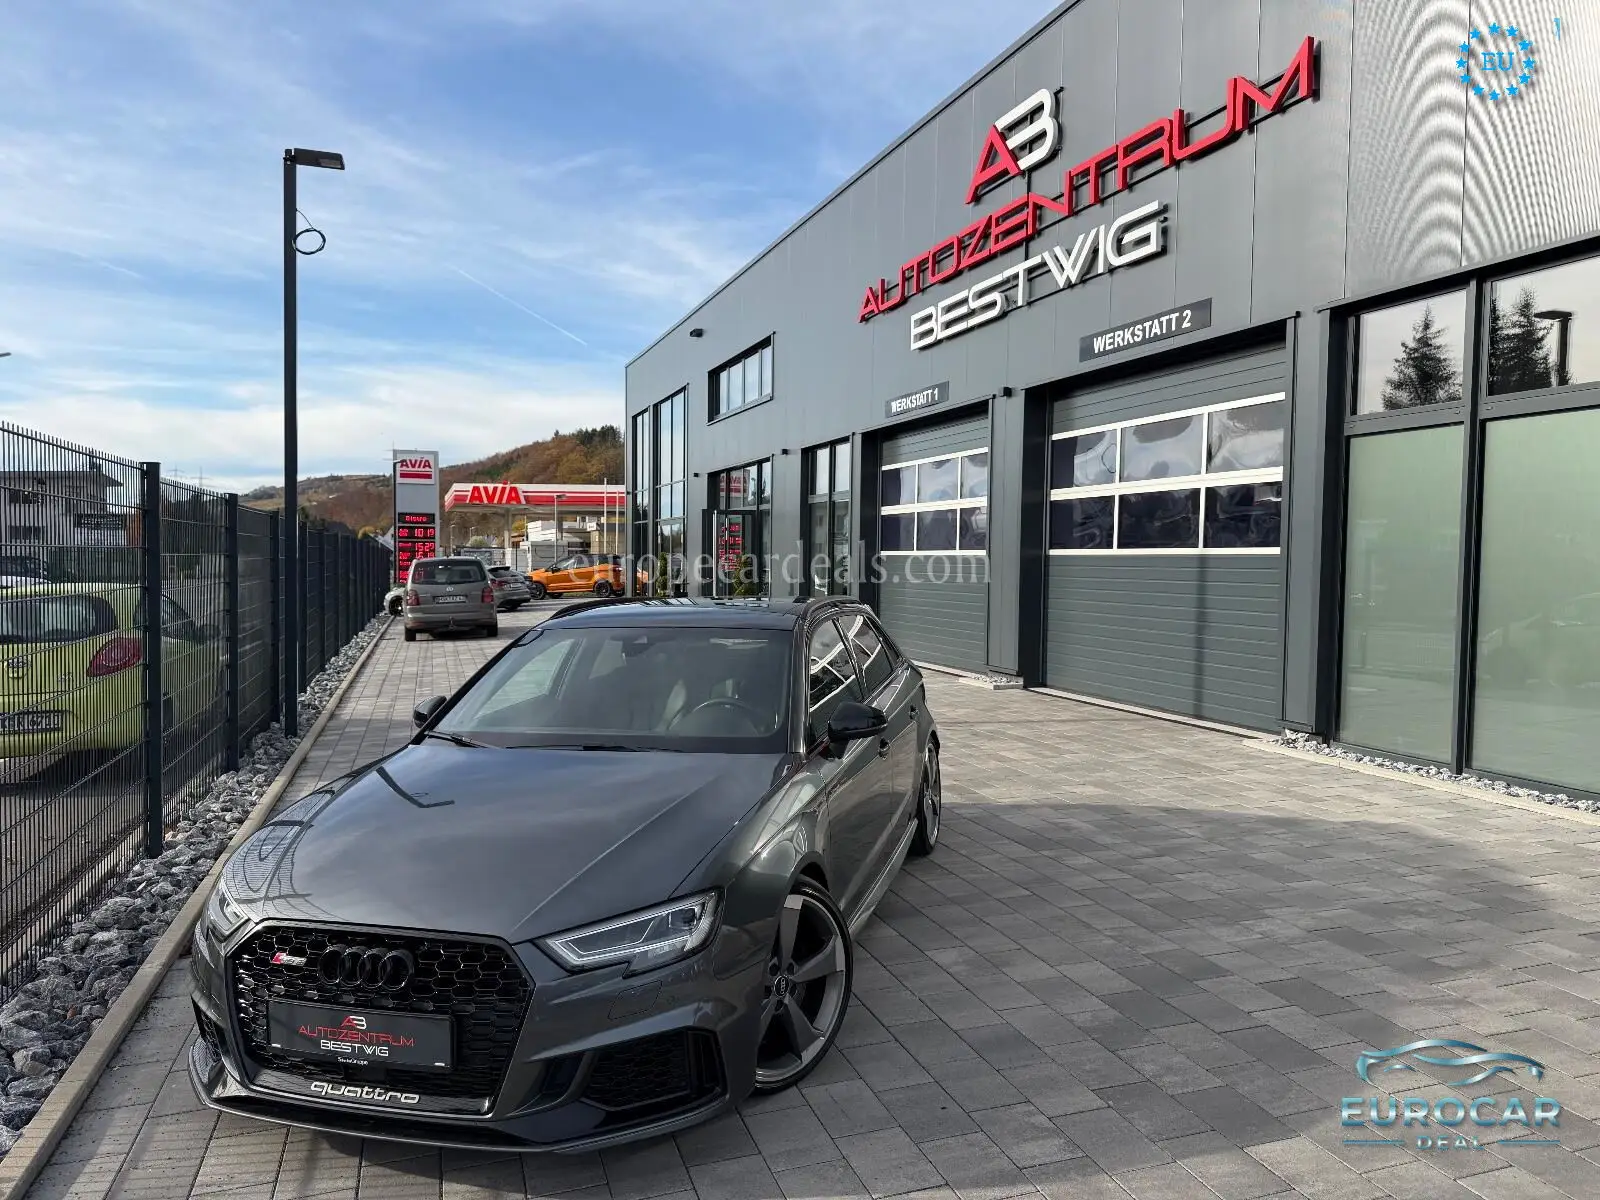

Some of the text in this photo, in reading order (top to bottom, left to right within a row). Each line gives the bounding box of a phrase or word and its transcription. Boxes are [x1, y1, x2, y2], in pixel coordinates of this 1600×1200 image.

[858, 36, 1319, 323] AUTOZENTRUM
[910, 200, 1165, 351] BESTWIG
[1093, 309, 1192, 354] WERKSTATT 2
[890, 387, 939, 414] WERKSTATT 1
[400, 456, 432, 469] AVIA
[466, 480, 525, 505] AVIA
[298, 1025, 415, 1048] AUTOZENTRUM
[320, 1039, 389, 1057] BESTWIG
[310, 1081, 420, 1104] quattro
